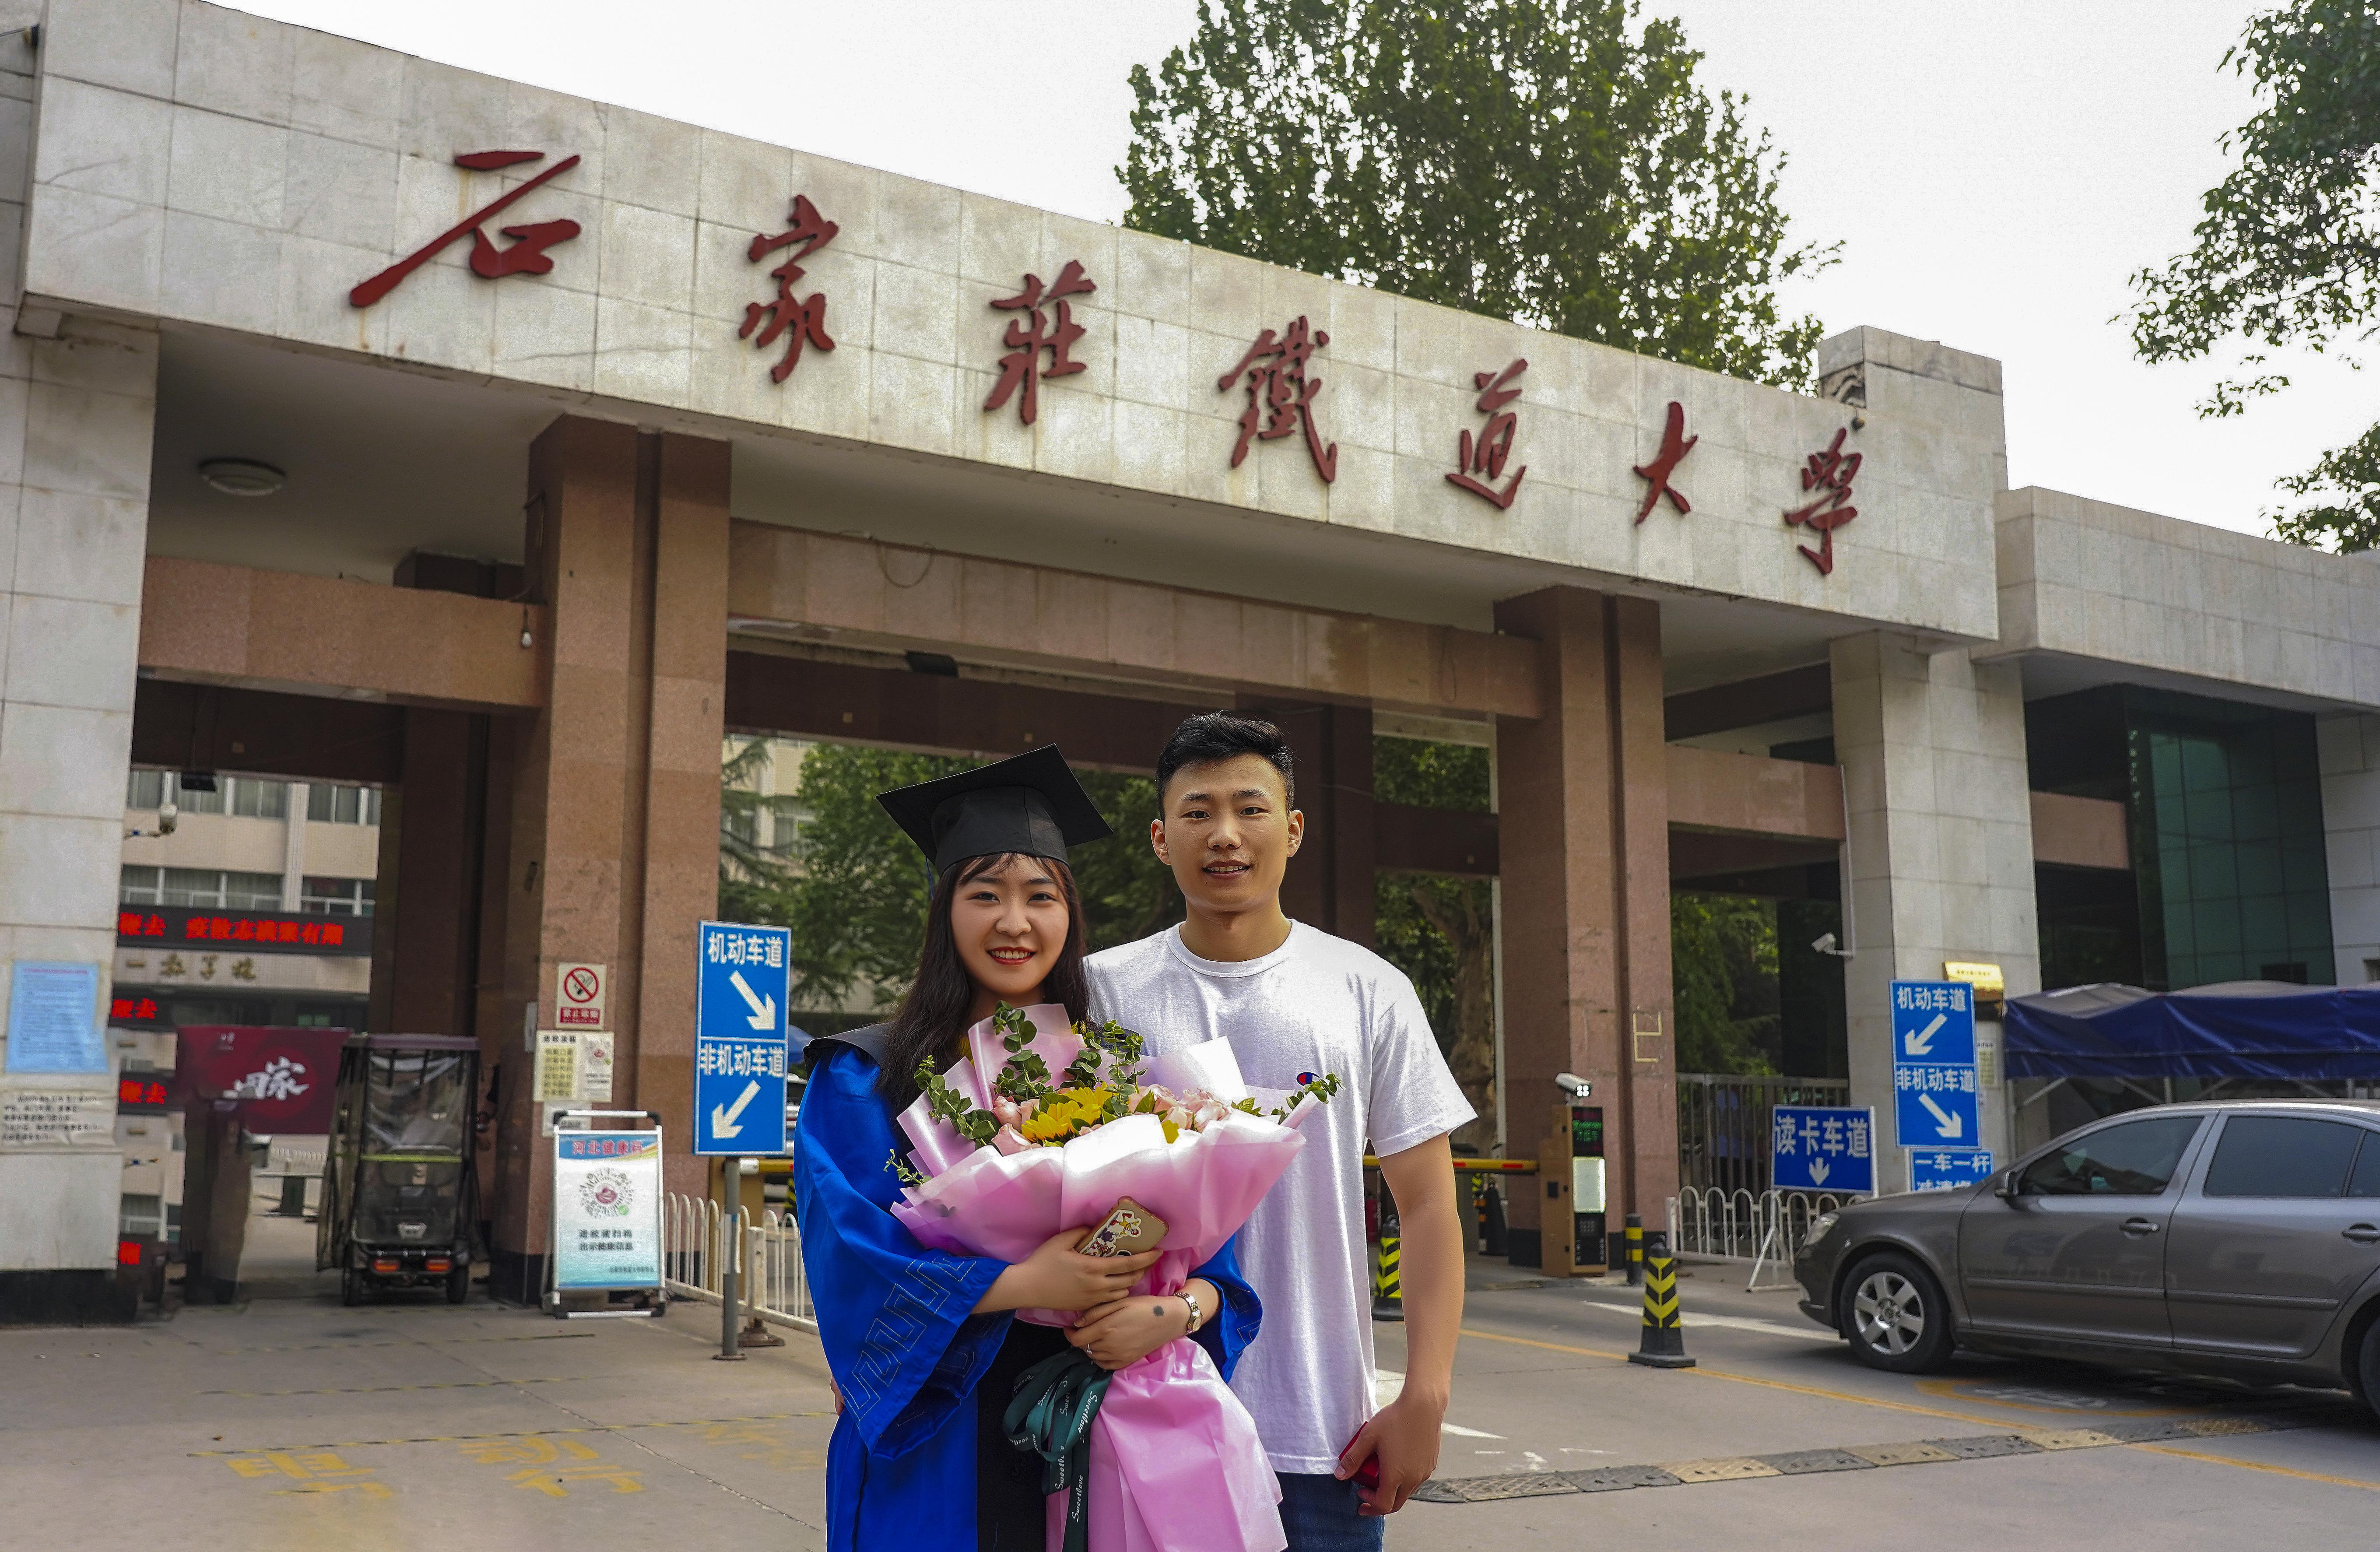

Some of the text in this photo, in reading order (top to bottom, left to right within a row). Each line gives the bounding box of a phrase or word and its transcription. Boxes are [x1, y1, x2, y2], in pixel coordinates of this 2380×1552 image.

[708, 931, 784, 968] 机动车道
[1897, 987, 1966, 1012] 机动车道
[700, 1043, 785, 1078] 非机动车道
[1896, 1068, 1975, 1093] 非机动车道
[1775, 1115, 1869, 1158] 读卡车道
[1915, 1153, 1990, 1173] 一车一杆
[579, 1229, 632, 1238] 进校请扫码
[579, 1242, 634, 1251] 出示健康信息
[1077, 1390, 1098, 1433] Sweetlove
[1072, 1475, 1083, 1523] Sweetlove
